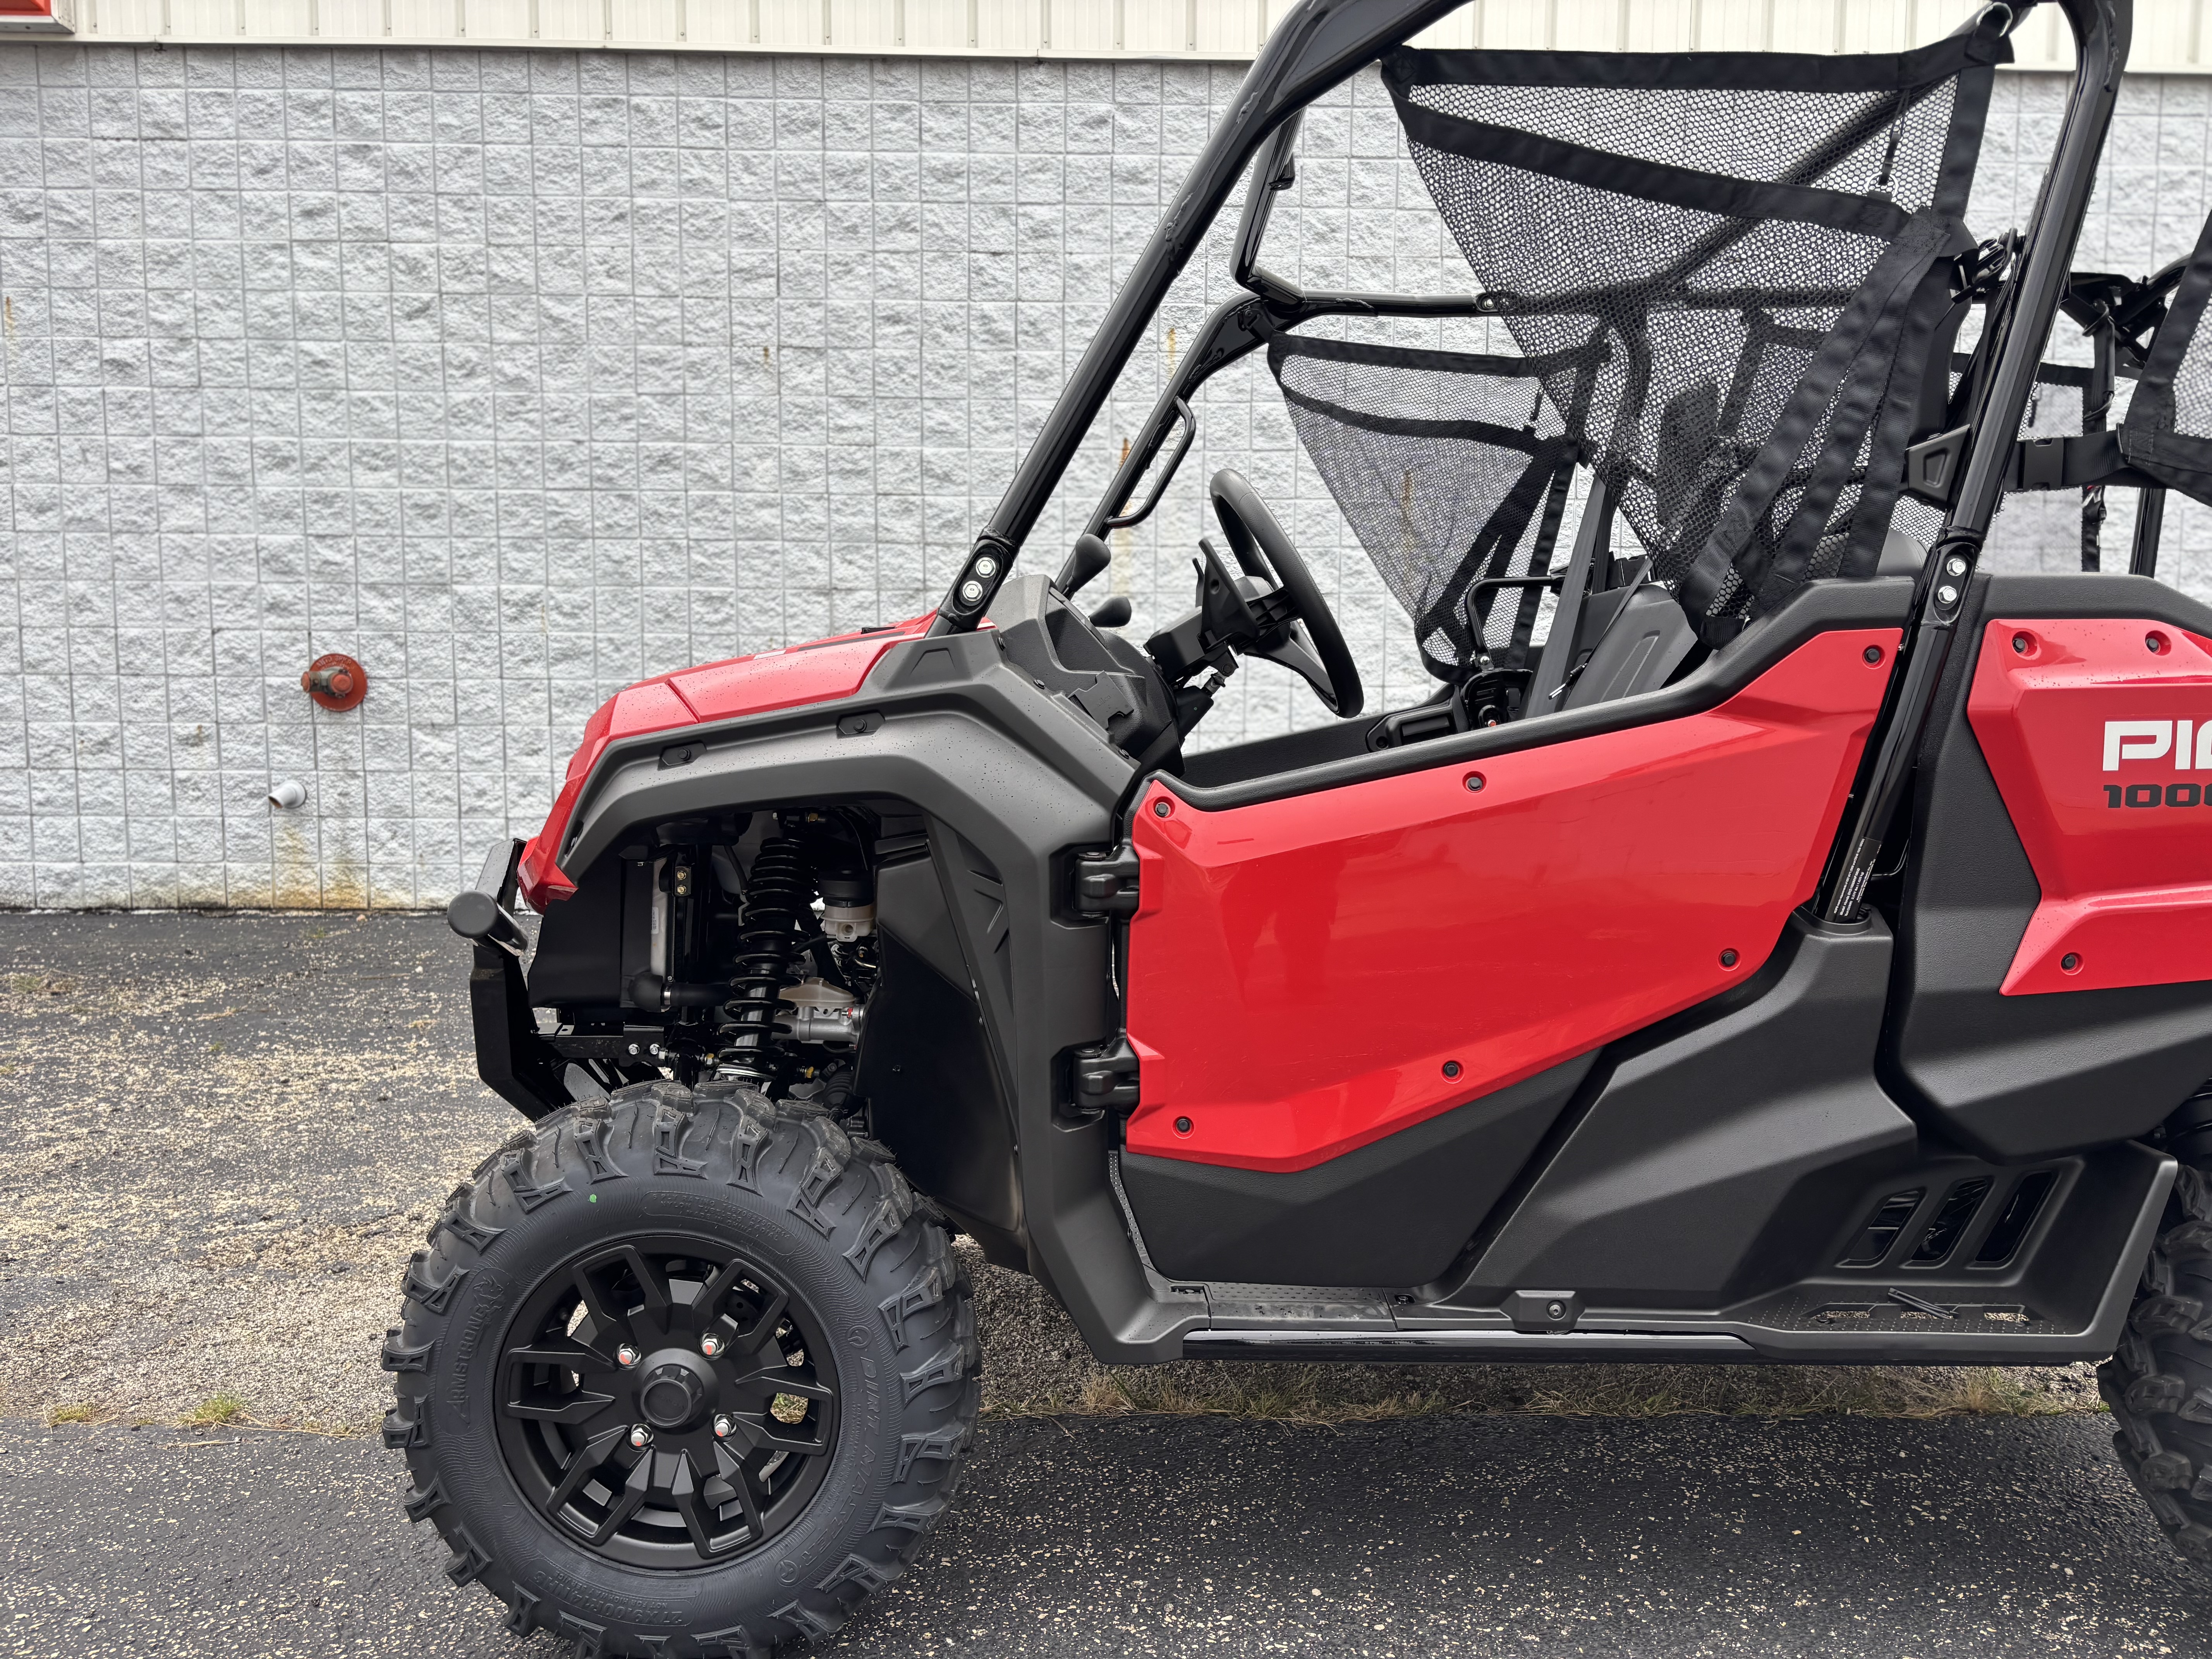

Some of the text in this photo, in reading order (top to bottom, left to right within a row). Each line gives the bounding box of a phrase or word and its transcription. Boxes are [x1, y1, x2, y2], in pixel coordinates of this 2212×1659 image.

[2102, 720, 2212, 771] PI
[2103, 783, 2212, 809] 100
[681, 1195, 716, 1206] RATING
[698, 1205, 742, 1221] TUBELESS
[446, 1304, 486, 1425] ARMSTRONG
[800, 1356, 882, 1567] DIRT MASTER
[555, 1570, 668, 1609] NOT FOR HIGHWAY SERVICE
